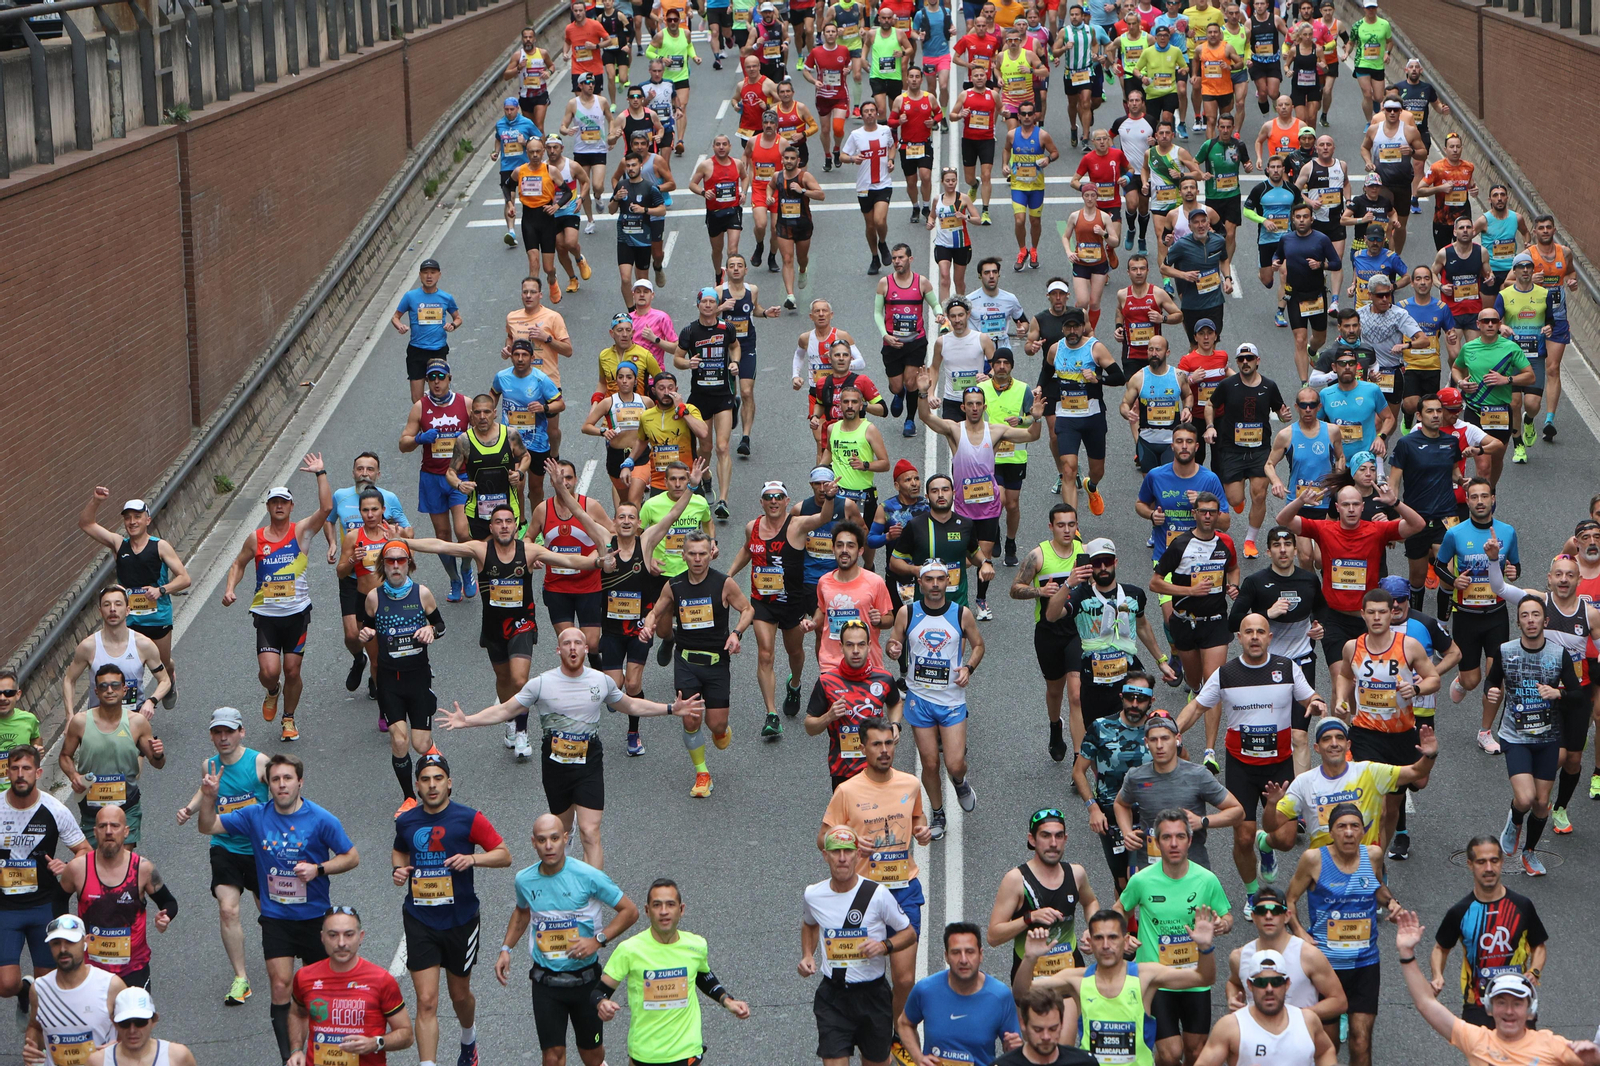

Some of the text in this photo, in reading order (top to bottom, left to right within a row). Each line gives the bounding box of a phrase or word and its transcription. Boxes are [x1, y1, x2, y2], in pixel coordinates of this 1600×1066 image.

[843, 449, 859, 457] 2015
[263, 556, 294, 565] PALACIEGO
[230, 795, 250, 803] ZURICH
[1330, 794, 1353, 802] ZURICH
[332, 999, 365, 1008] FUNDACIÓN
[332, 1010, 365, 1026] ALBOR
[943, 1051, 969, 1060] ZURICH
